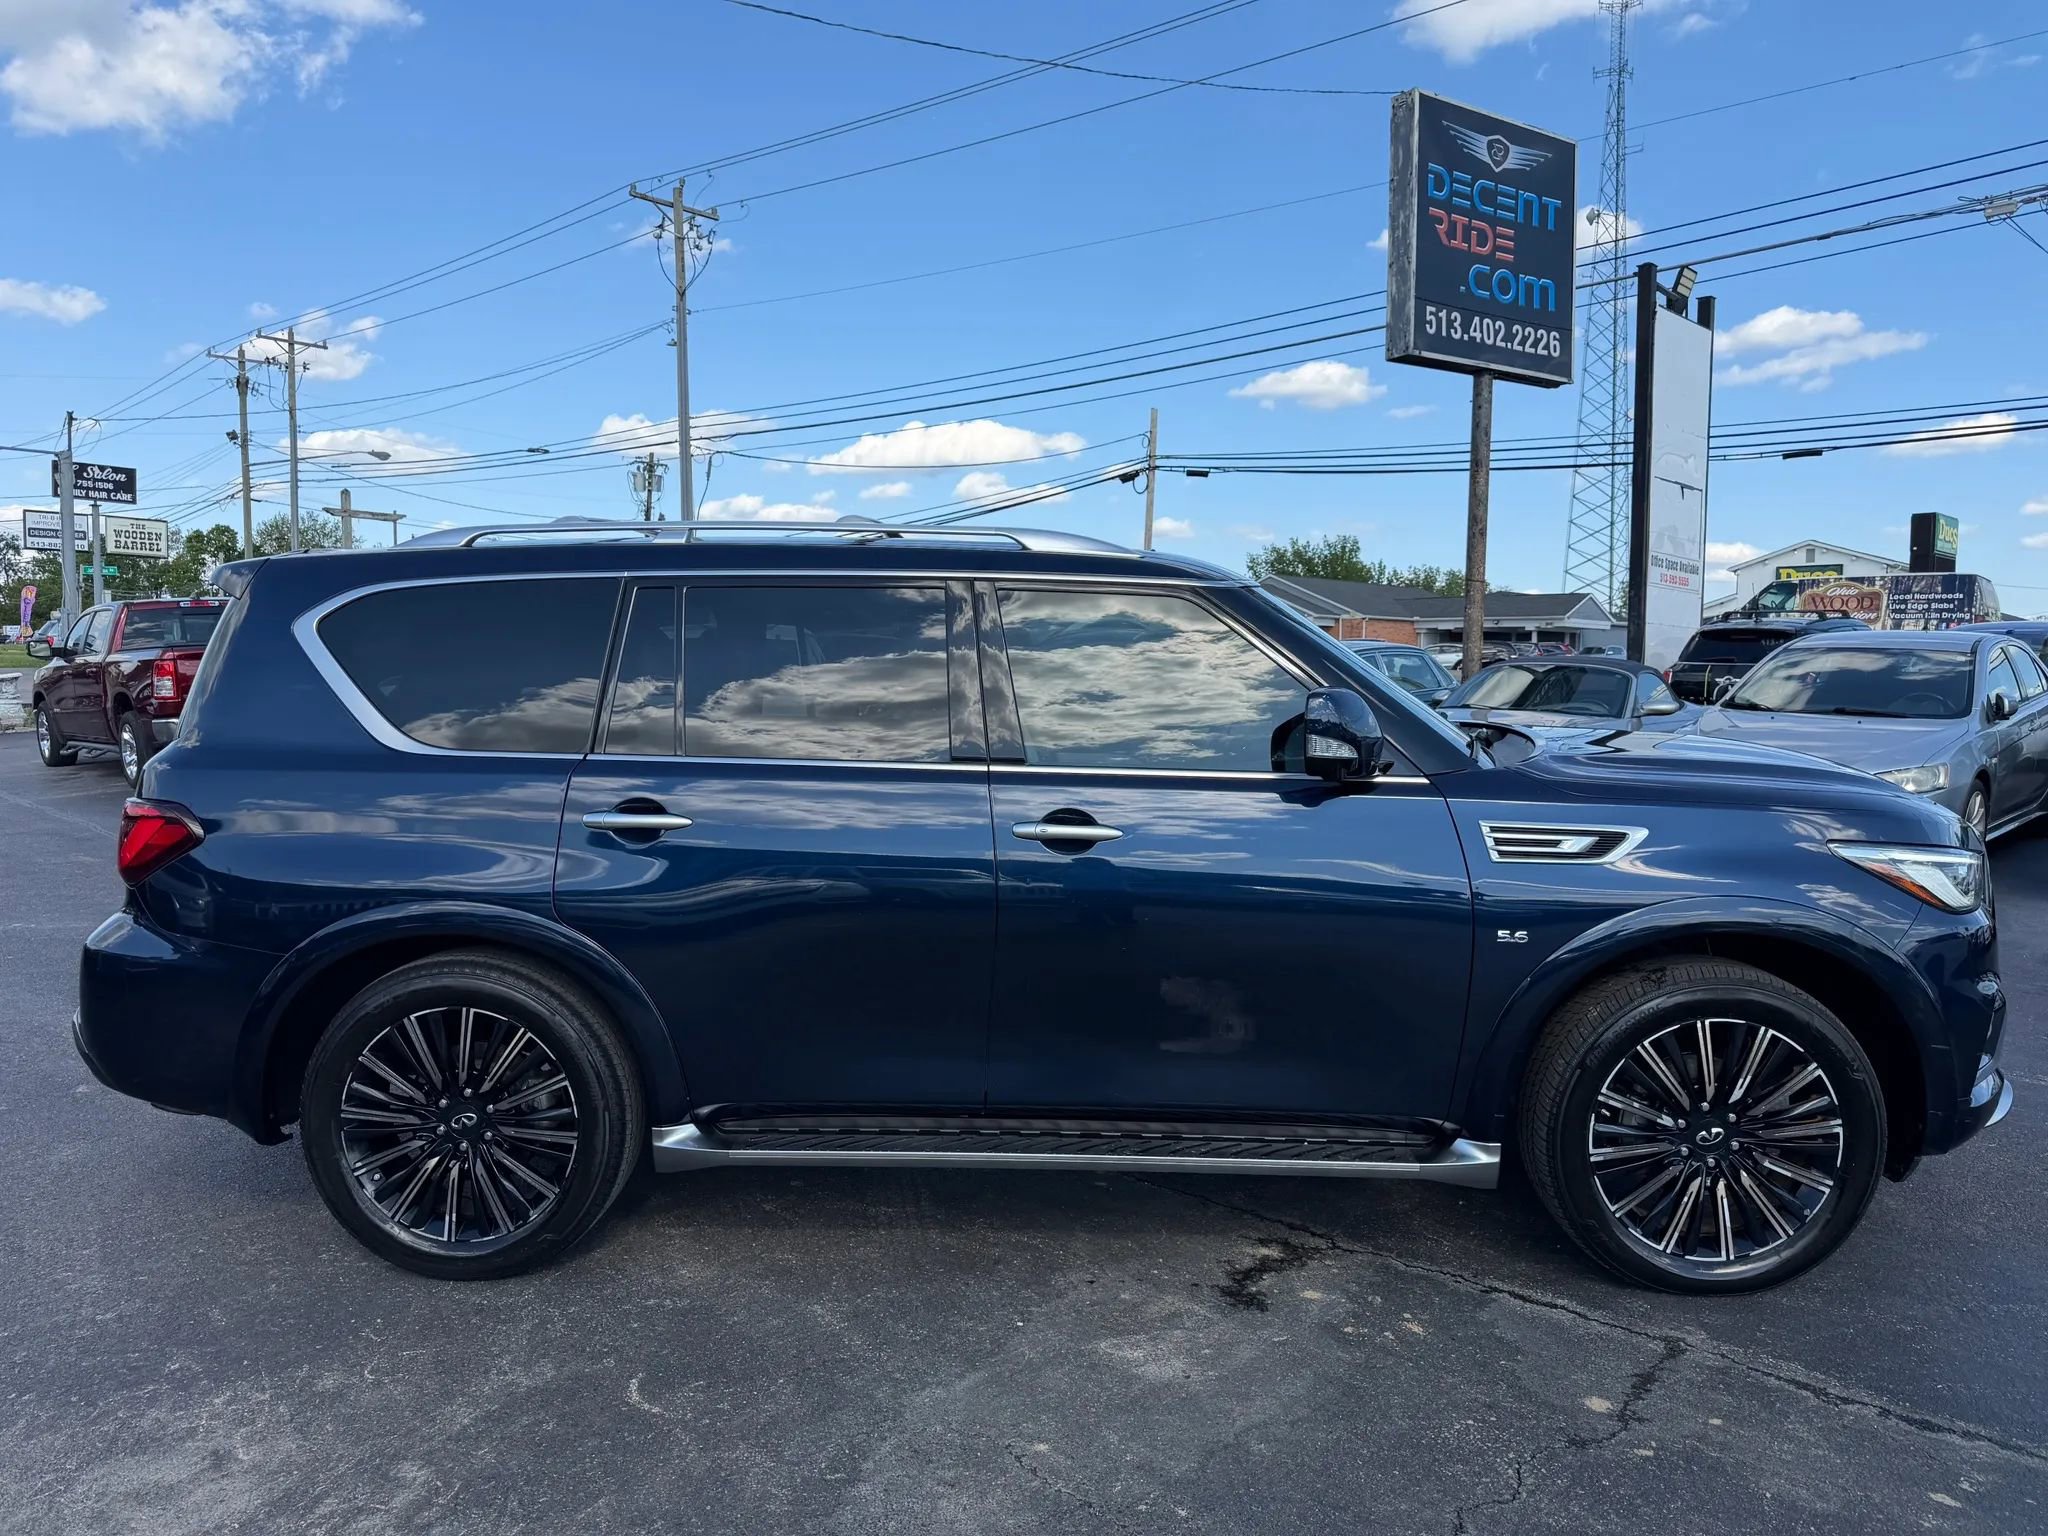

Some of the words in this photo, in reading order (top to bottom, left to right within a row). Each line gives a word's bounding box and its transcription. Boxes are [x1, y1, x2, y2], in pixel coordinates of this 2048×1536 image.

[1428, 162, 1562, 231] DECENT
[1428, 206, 1515, 261] RIDE
[1425, 305, 1561, 358] 513.402.2226
[83, 465, 127, 482] Salon
[88, 490, 108, 499] HAIR
[110, 492, 133, 501] CARE
[30, 529, 56, 537] DESIGN
[113, 529, 162, 542] WOODEN
[114, 539, 162, 552] BARREL
[1665, 557, 1679, 571] Space
[1827, 586, 1859, 597] Ohio
[1914, 592, 1964, 600] Hardwoods
[1810, 596, 1874, 610] WOOD
[1942, 611, 1971, 619] Drying
